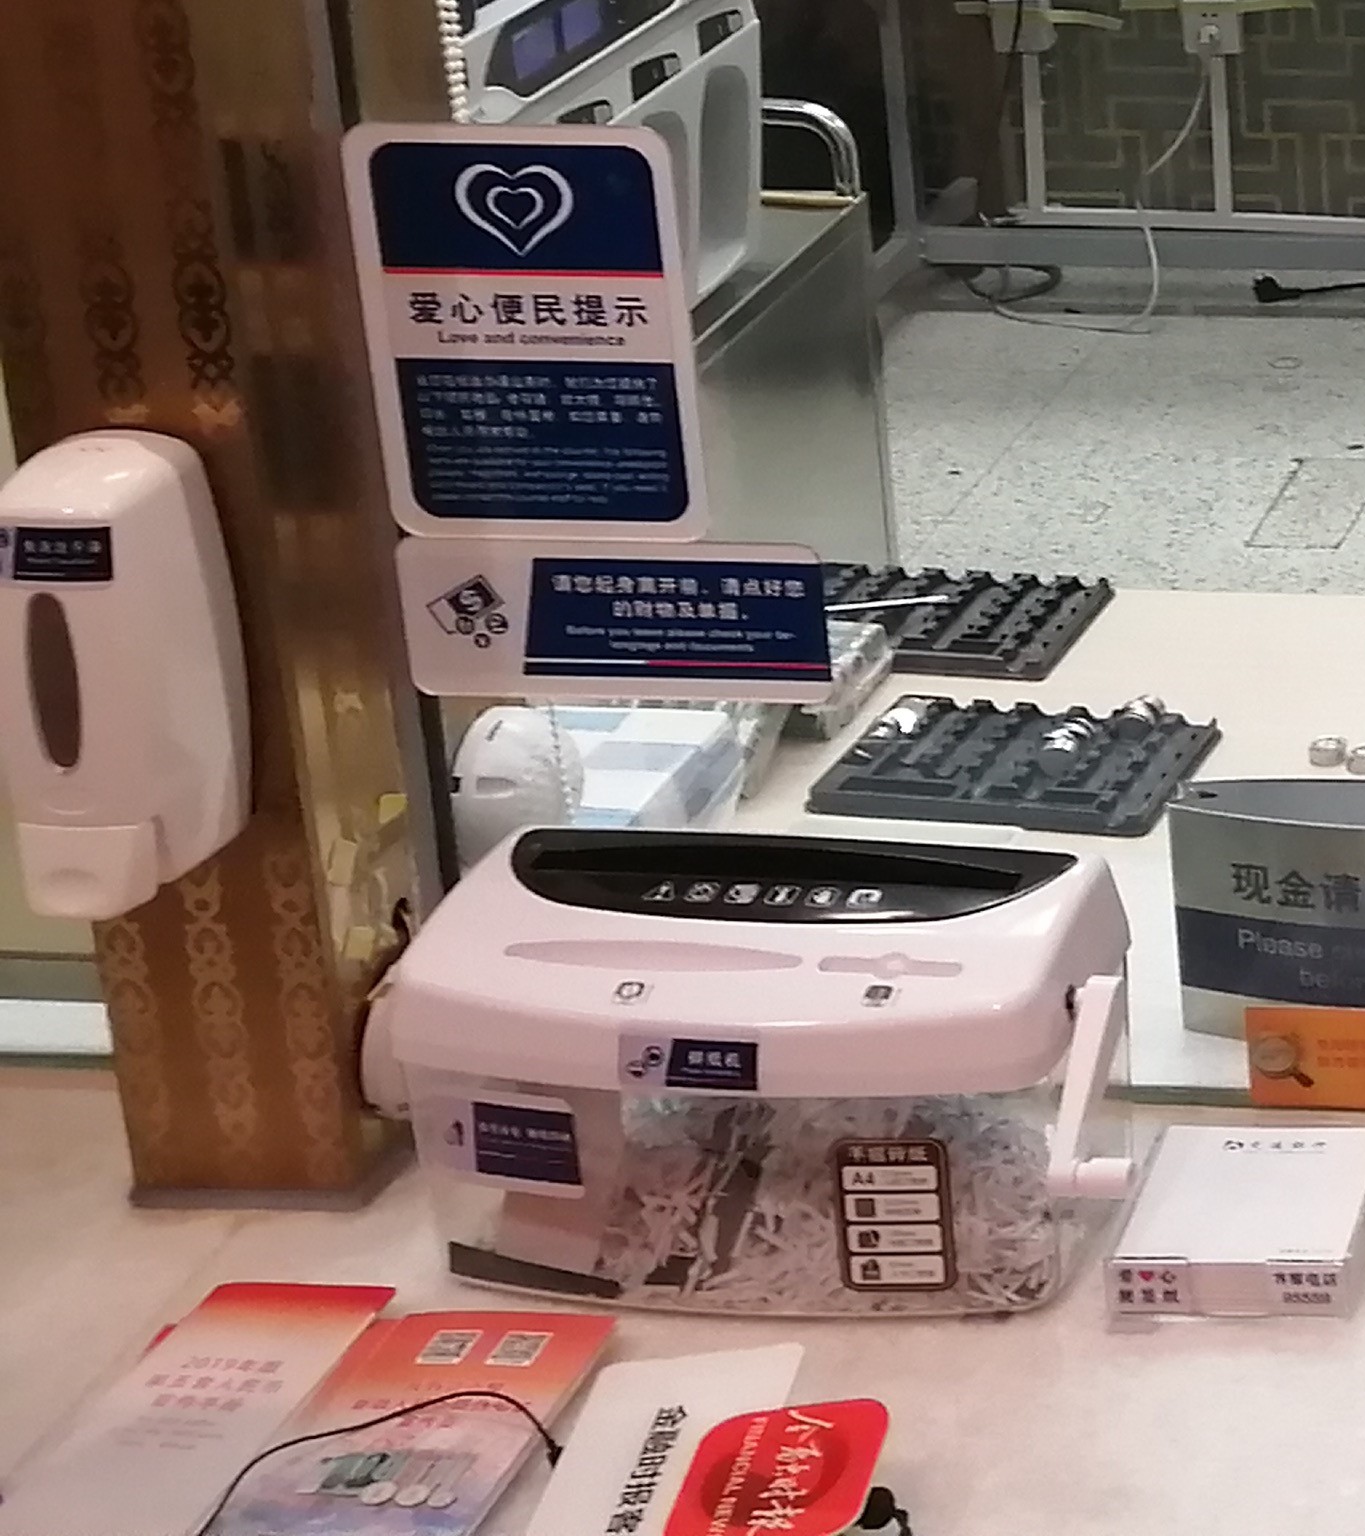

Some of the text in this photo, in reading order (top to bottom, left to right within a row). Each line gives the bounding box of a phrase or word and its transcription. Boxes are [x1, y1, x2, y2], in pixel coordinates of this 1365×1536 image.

[408, 291, 649, 328] 爱心便民提示
[438, 330, 478, 345] Love
[484, 332, 515, 346] and
[1237, 929, 1324, 960] Please
